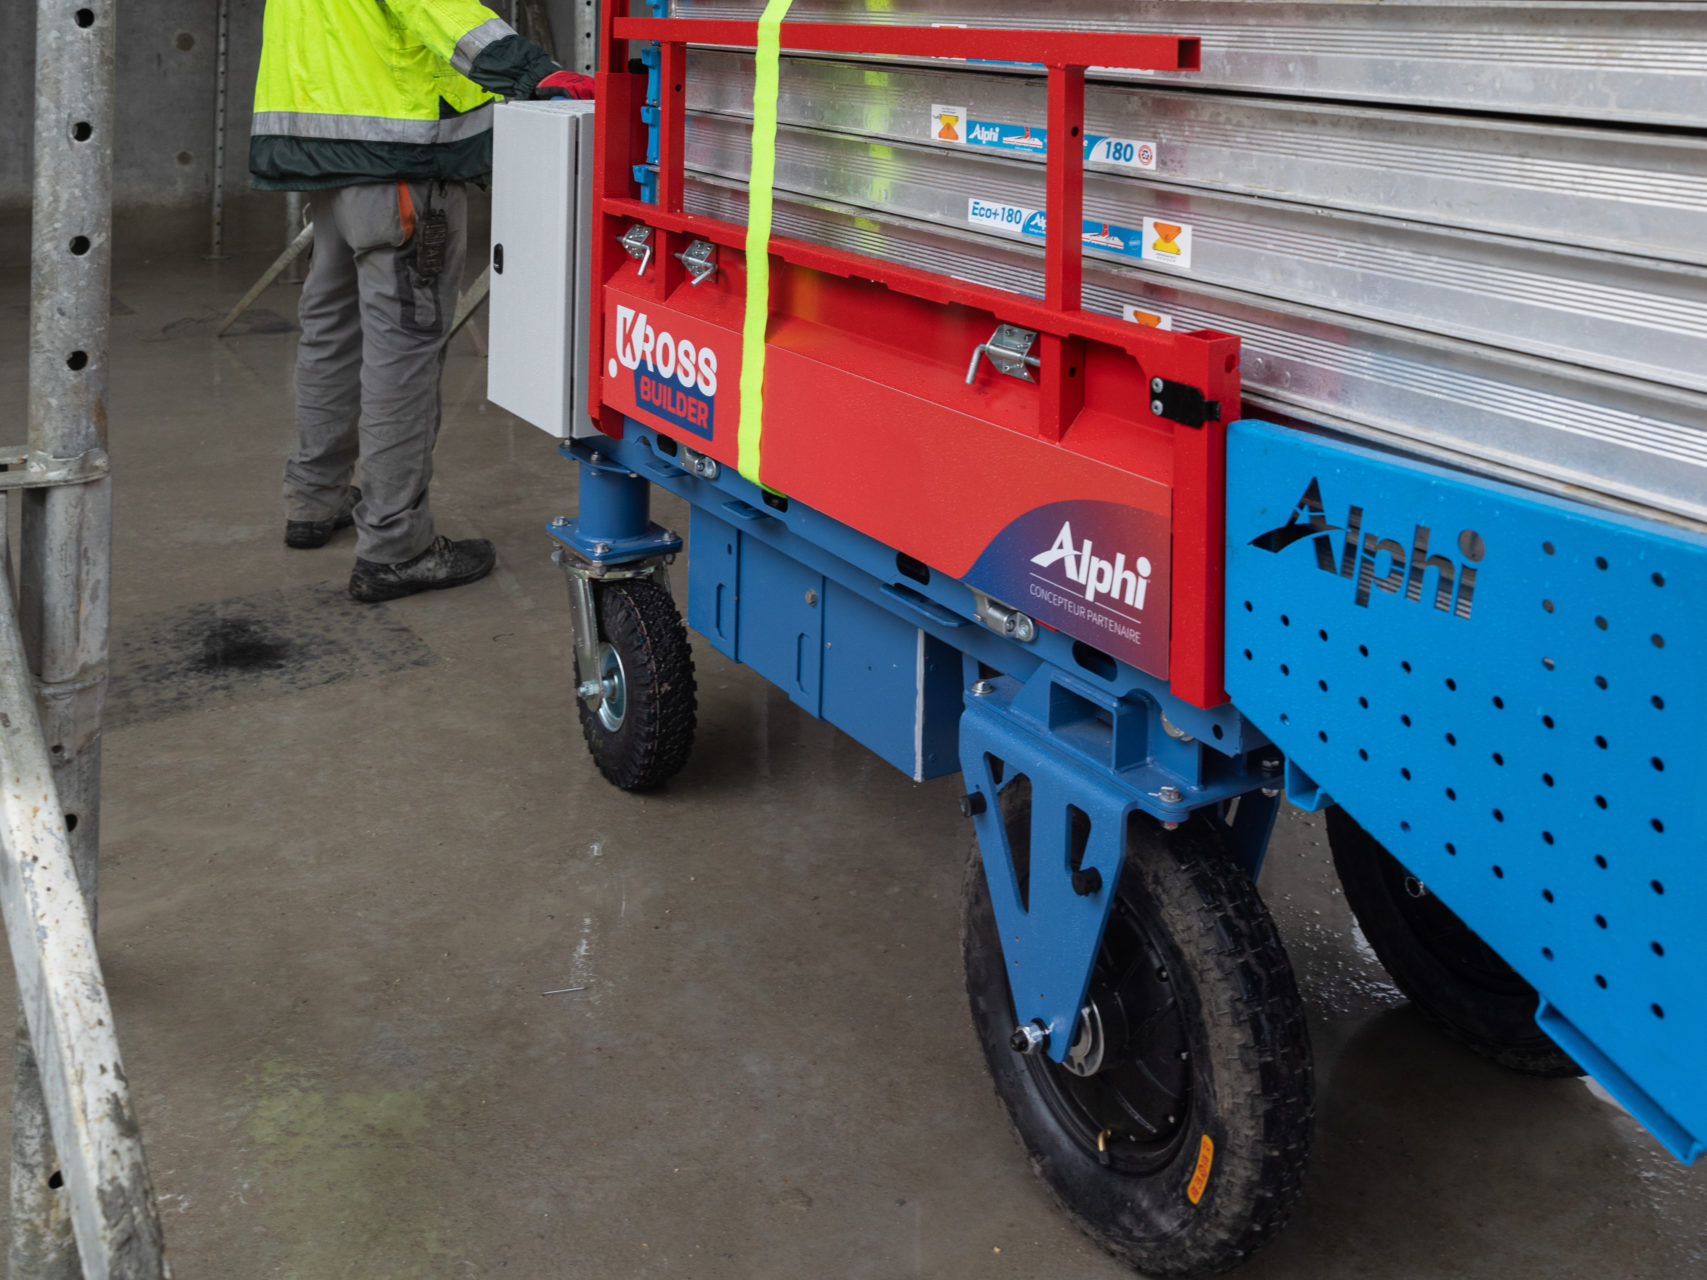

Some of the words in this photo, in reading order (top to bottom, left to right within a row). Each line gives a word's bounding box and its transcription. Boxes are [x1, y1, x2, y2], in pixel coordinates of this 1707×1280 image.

[968, 123, 1000, 144] Alphi
[1105, 141, 1134, 162] 180
[971, 201, 1022, 225] Eco+180
[639, 375, 709, 429] BUILDER
[1030, 520, 1152, 611] Alphi
[1247, 476, 1485, 620] Alphi
[1029, 583, 1086, 620] CONCEPTEUR
[1087, 609, 1141, 645] PARTENAIRE
